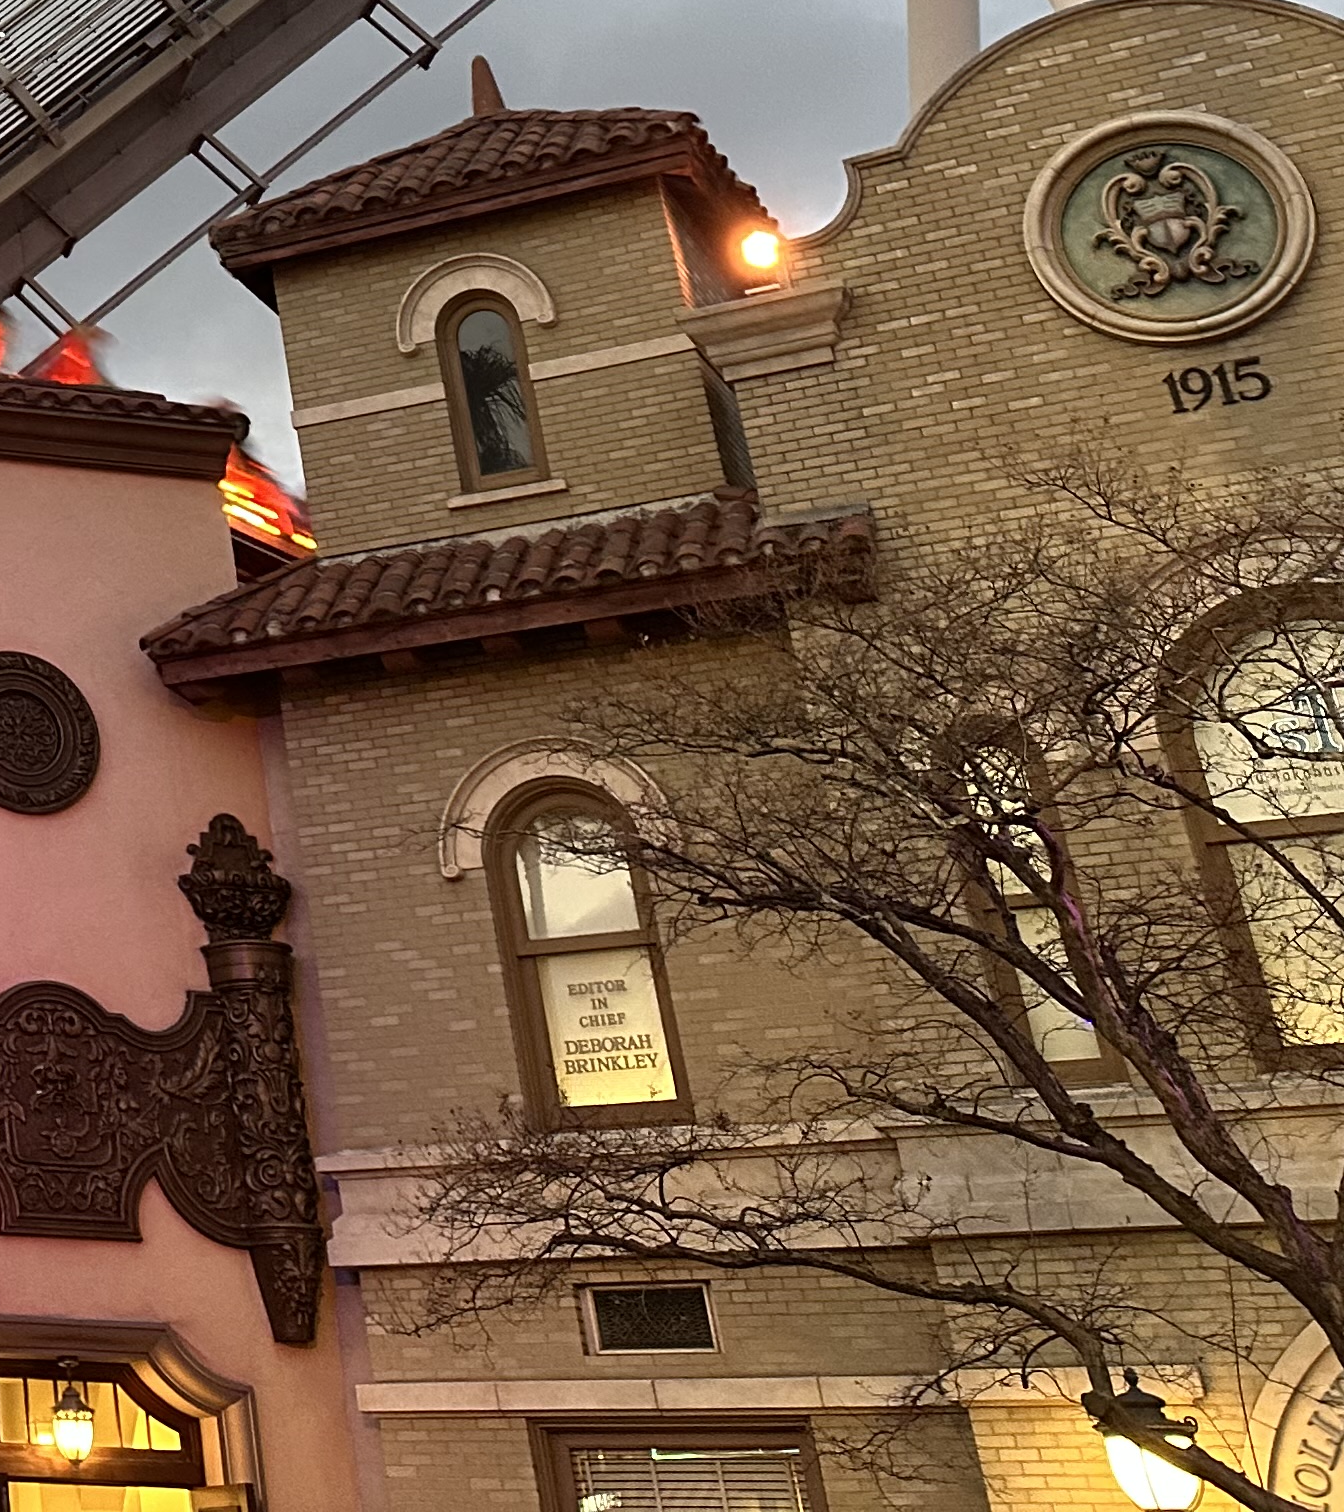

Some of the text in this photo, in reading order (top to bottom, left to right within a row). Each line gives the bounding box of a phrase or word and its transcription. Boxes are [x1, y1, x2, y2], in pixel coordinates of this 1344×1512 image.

[1162, 356, 1271, 414] 1915
[567, 979, 628, 996] EDITOR
[591, 997, 609, 1010] IN
[578, 1013, 627, 1028] CHIEF
[564, 1034, 653, 1055] DEBORAH
[563, 1053, 659, 1074] BRINKLEY
